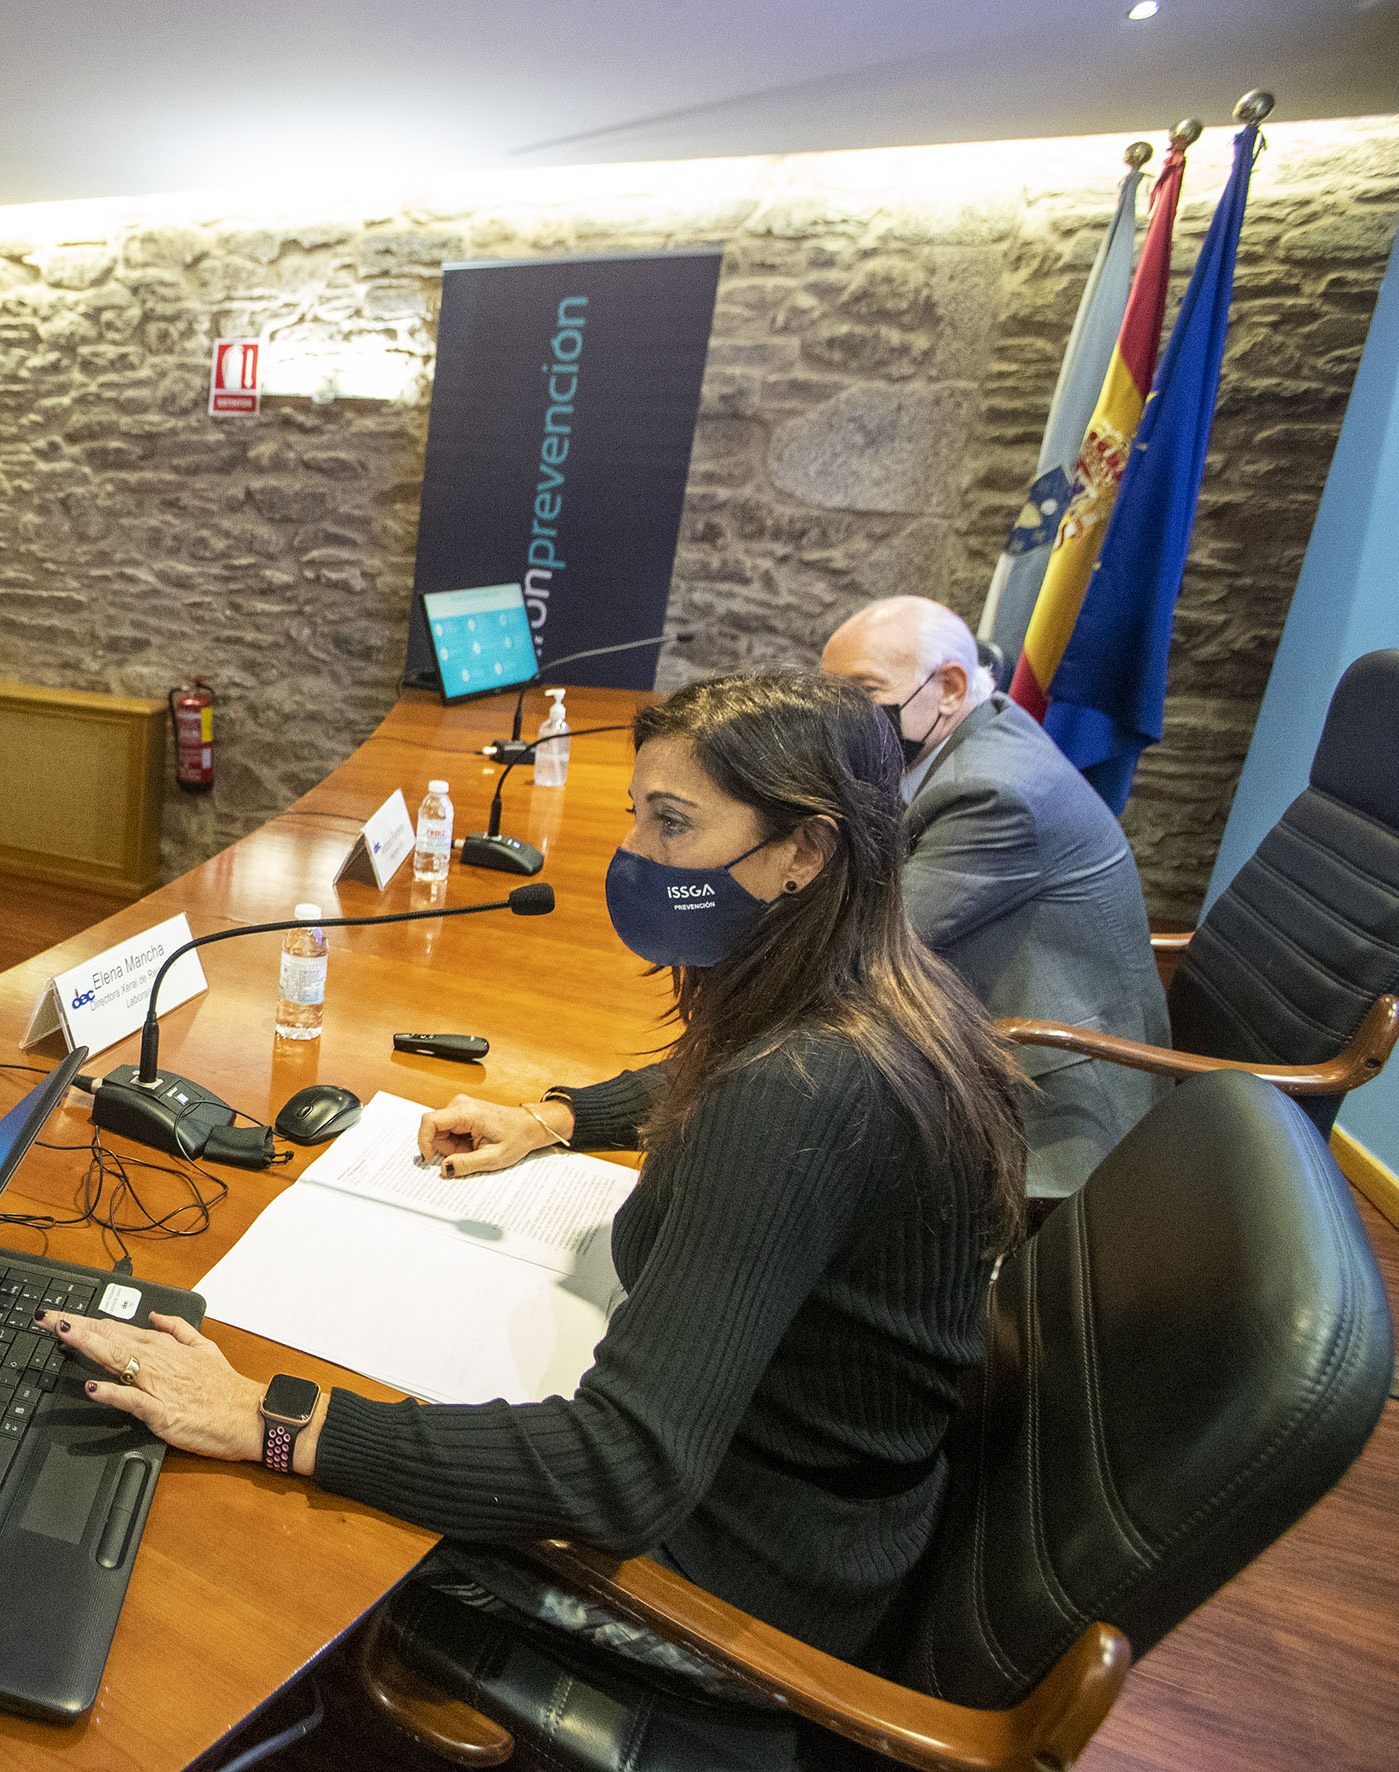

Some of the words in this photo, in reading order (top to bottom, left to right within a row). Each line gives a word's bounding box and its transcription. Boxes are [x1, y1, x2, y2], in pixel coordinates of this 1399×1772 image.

[674, 901, 715, 910] PREVENCIÓN
[92, 964, 123, 990] Elena
[124, 944, 165, 974] Mancha
[90, 987, 121, 1012] Directora
[120, 978, 138, 995] Xeral
[139, 974, 147, 985] de
